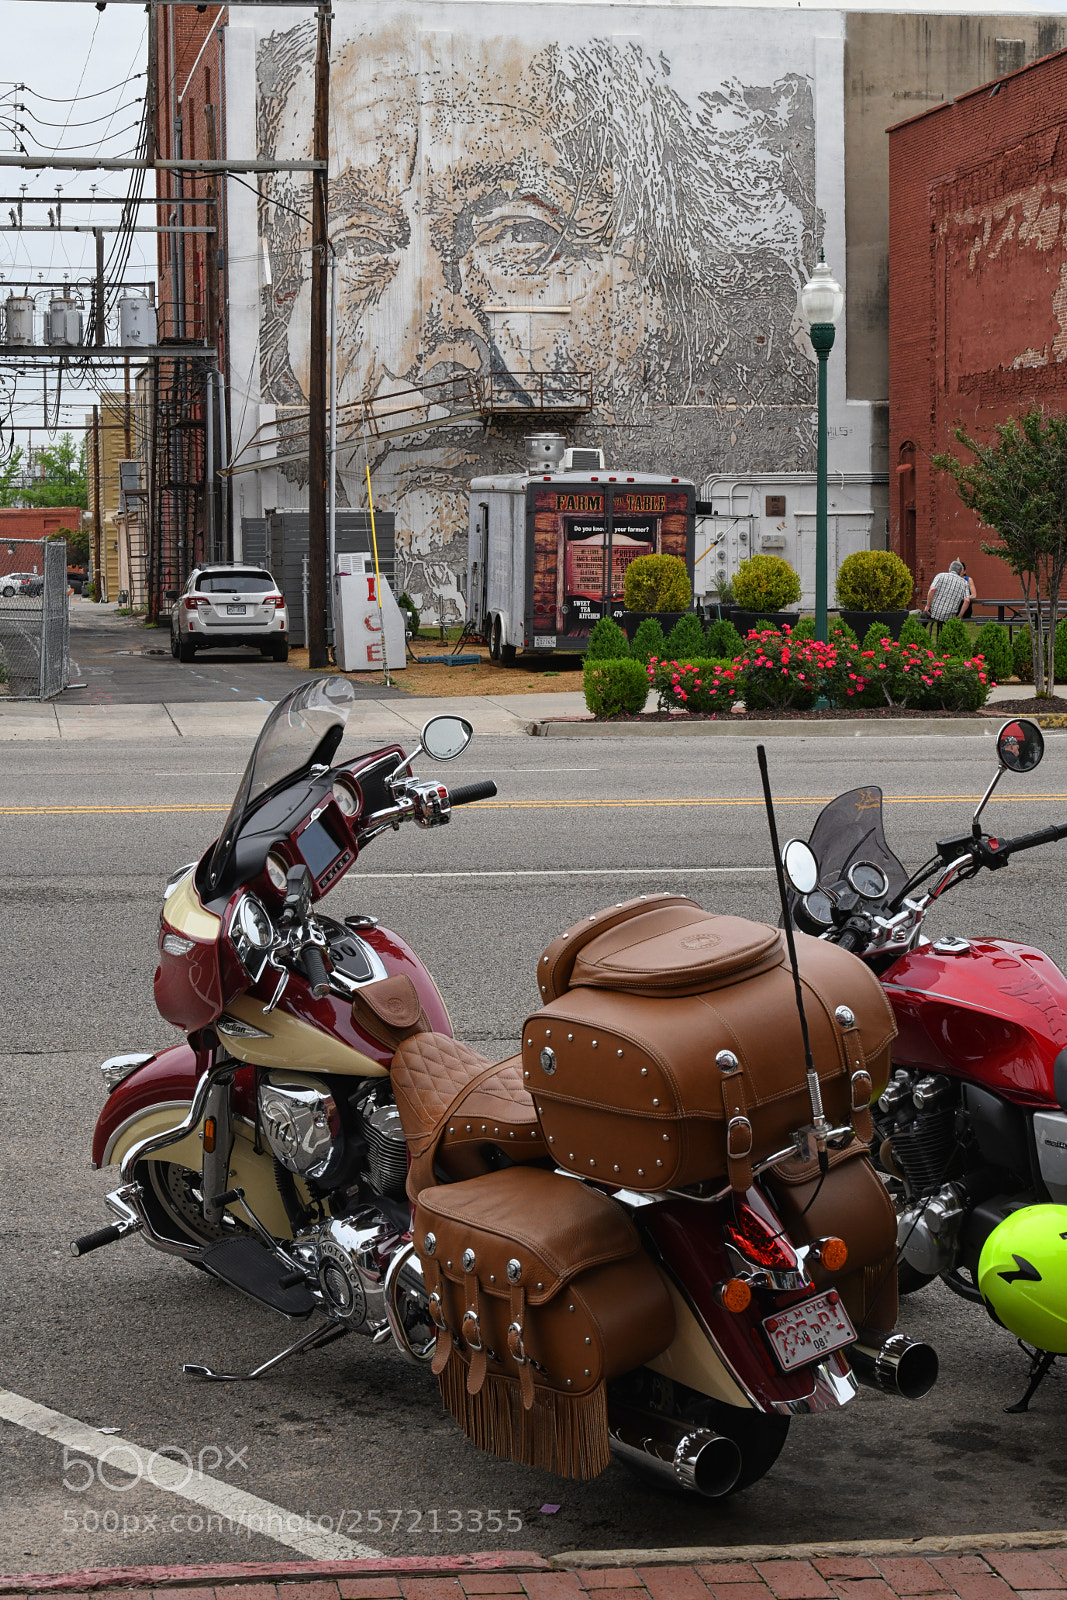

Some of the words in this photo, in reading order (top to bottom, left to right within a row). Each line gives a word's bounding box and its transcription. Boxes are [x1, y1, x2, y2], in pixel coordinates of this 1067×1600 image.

[555, 495, 602, 511] FARM
[626, 495, 667, 512] TABLE
[364, 577, 383, 662] ICE
[578, 612, 601, 620] KITCHEN
[320, 1243, 363, 1318] MOTORCYCLE
[805, 1299, 829, 1315] CYCL
